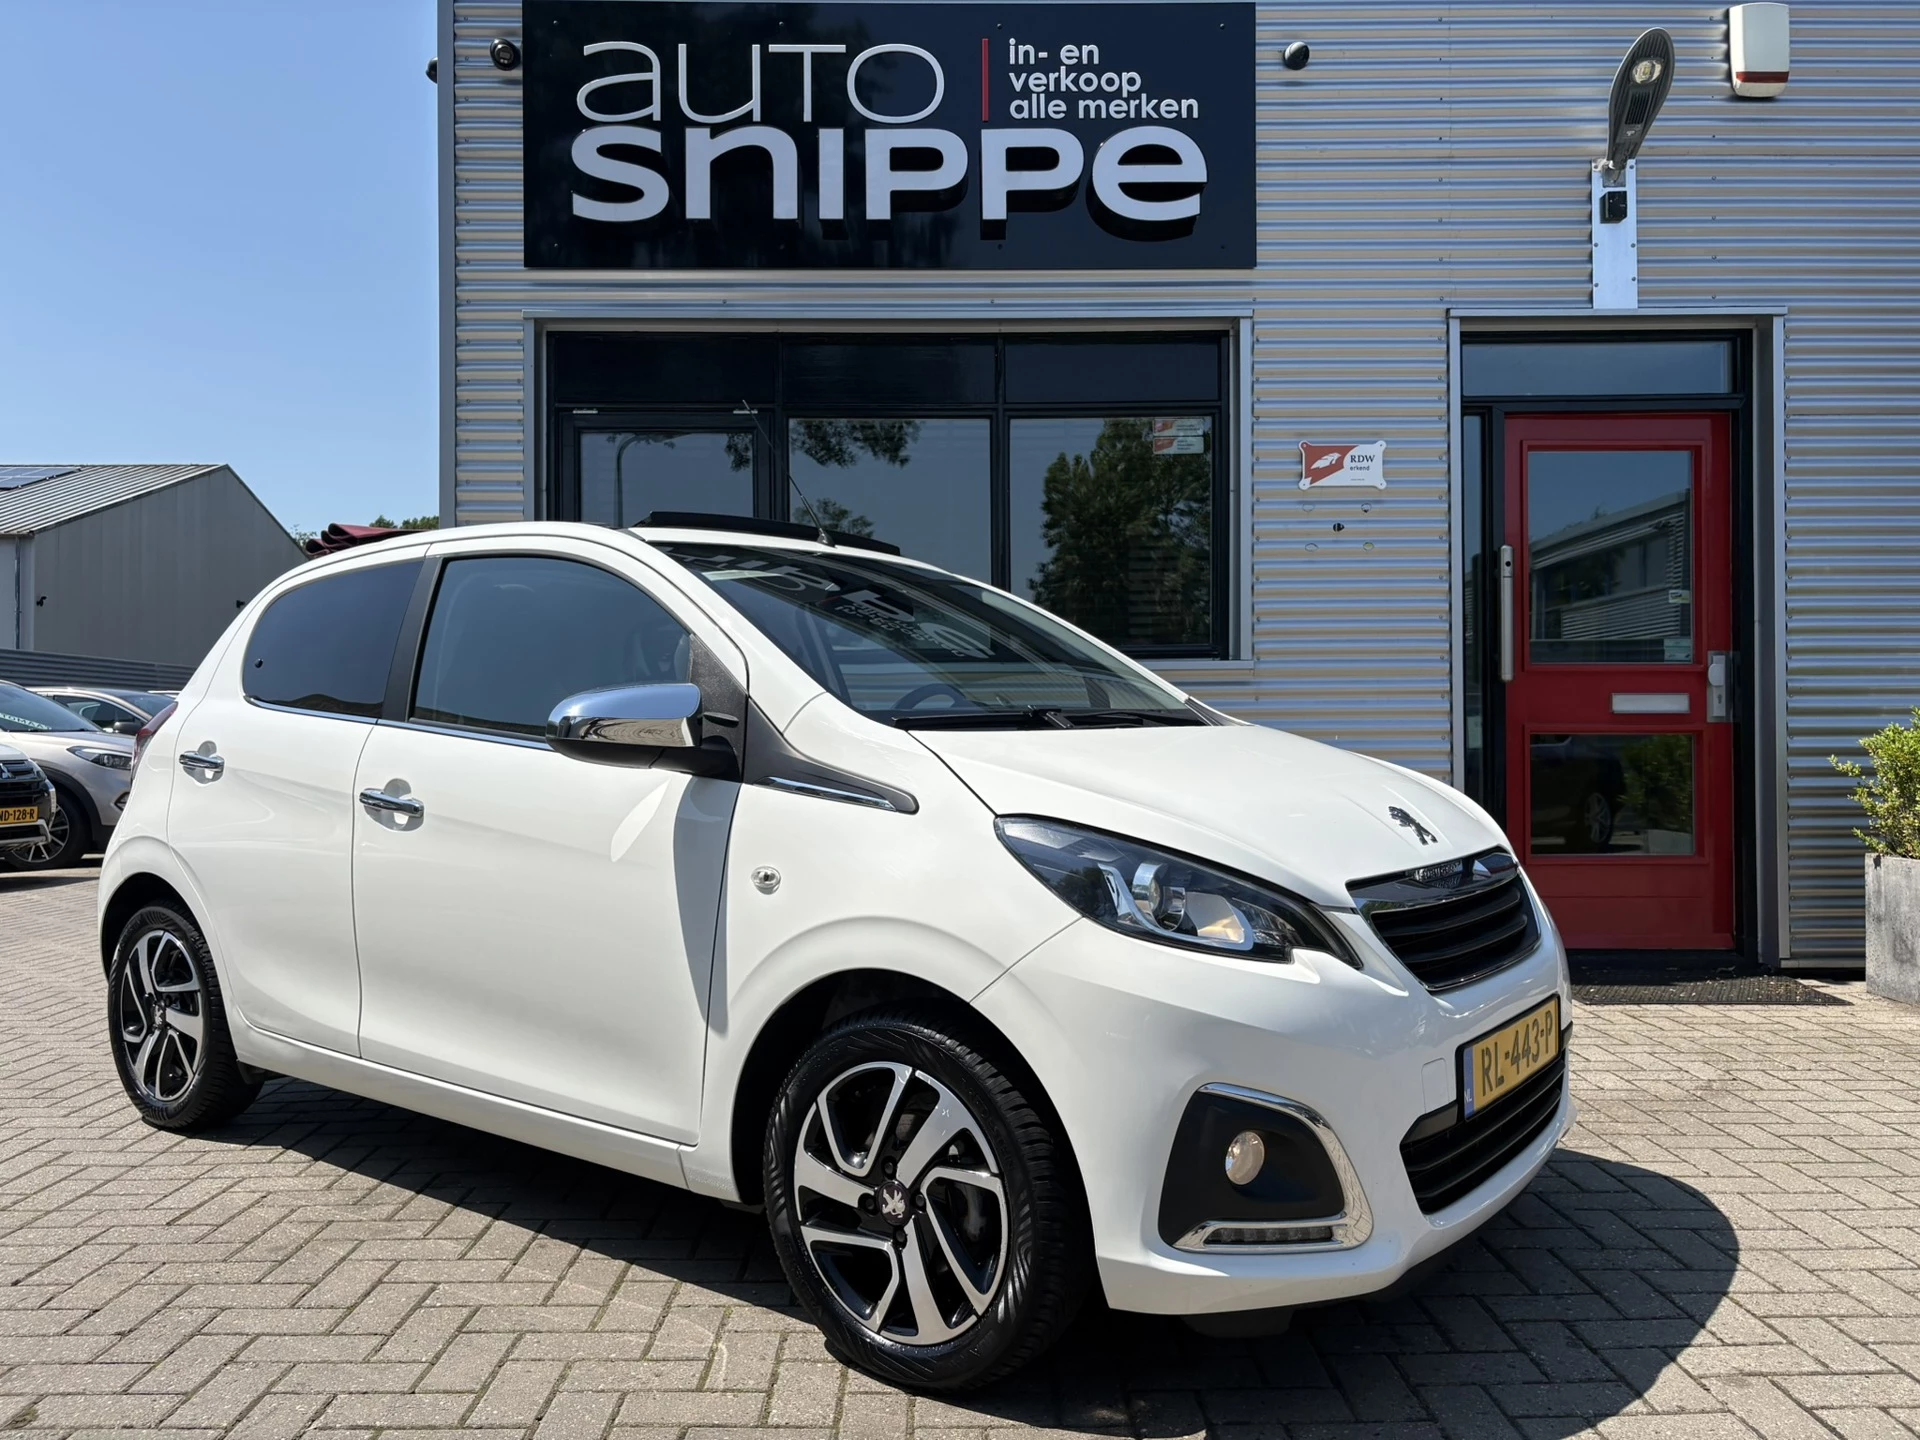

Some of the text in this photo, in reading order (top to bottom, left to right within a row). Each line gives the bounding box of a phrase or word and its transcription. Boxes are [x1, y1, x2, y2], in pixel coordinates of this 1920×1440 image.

[1009, 38, 1099, 65] in- en
[1009, 66, 1142, 98] verkoop
[1009, 93, 1199, 119] alle merken
[1350, 454, 1376, 463] RDW
[1481, 1010, 1553, 1097] RL-443-P
